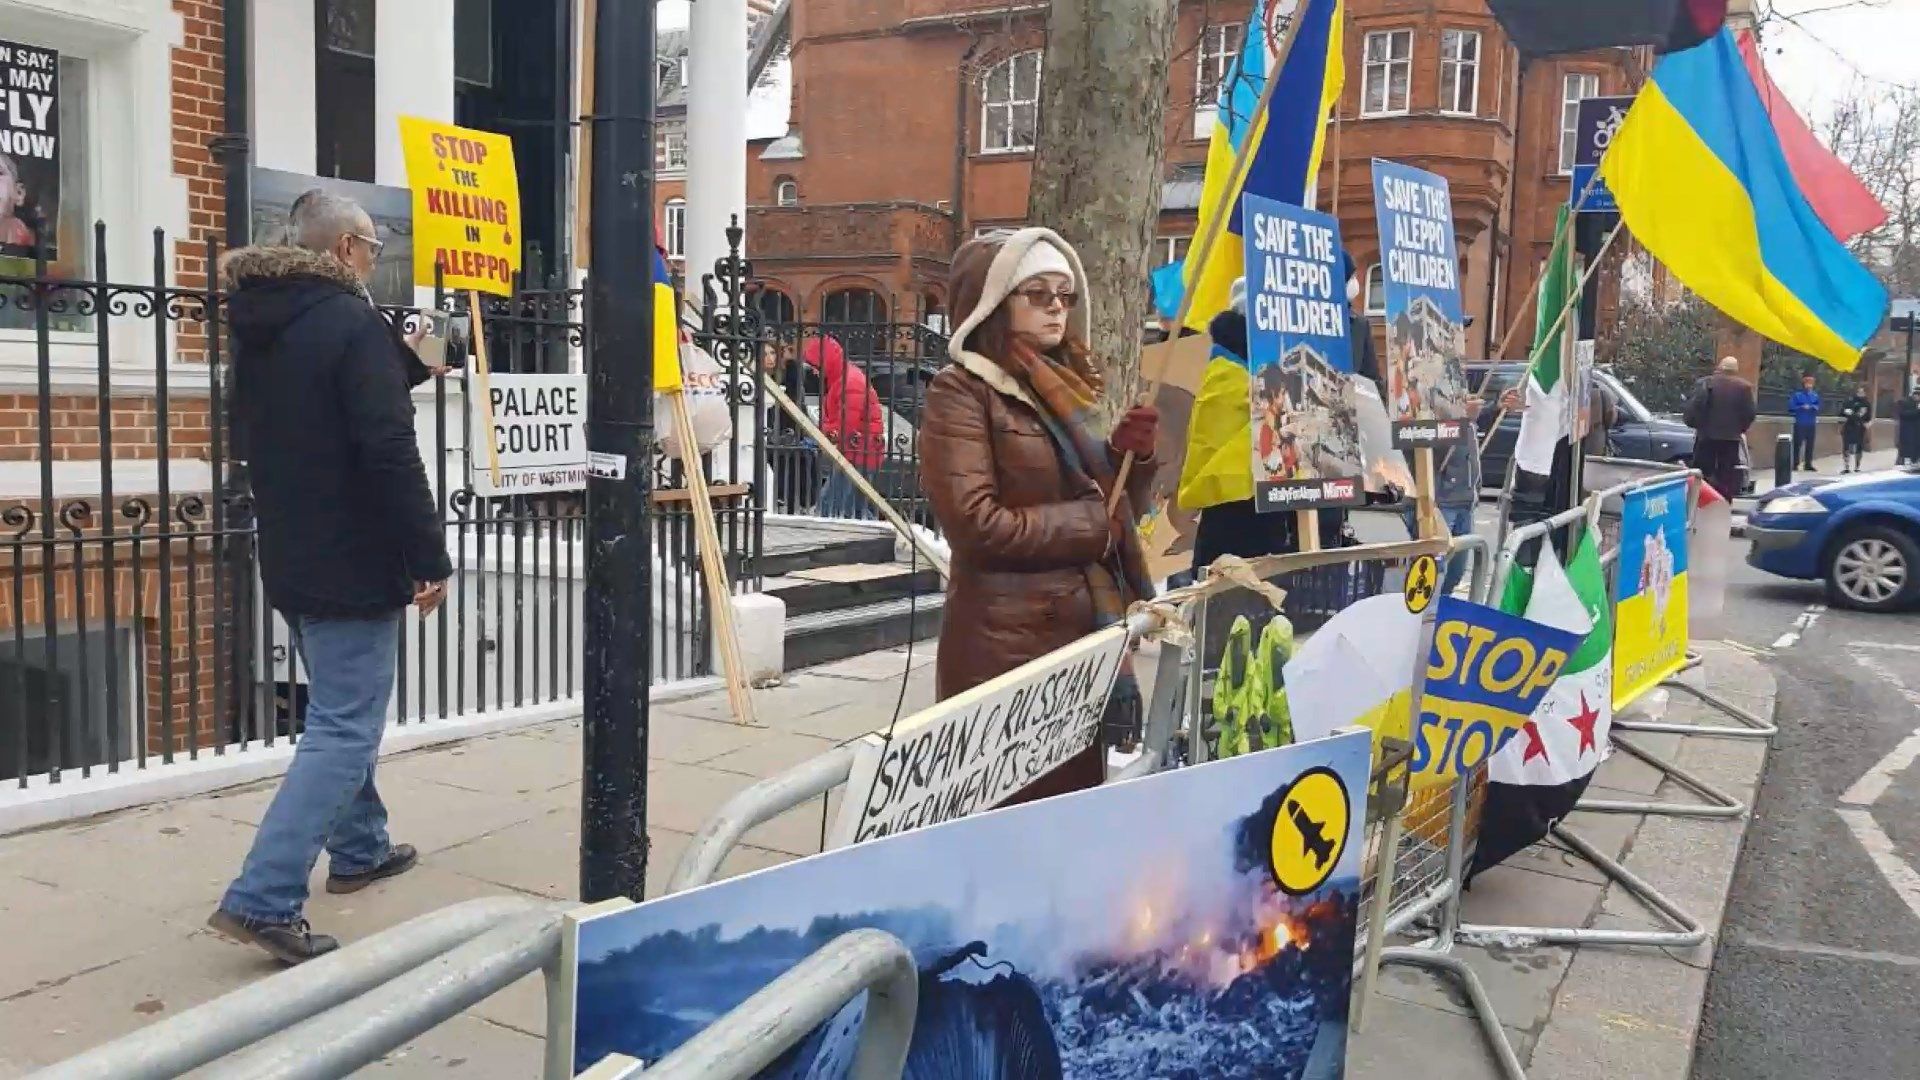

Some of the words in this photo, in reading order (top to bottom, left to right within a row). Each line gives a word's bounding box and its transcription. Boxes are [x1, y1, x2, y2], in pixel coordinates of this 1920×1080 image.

[17, 49, 54, 70] SAY:
[9, 68, 54, 92] MAY
[432, 133, 488, 165] STOP
[451, 168, 480, 188] THE
[427, 187, 508, 225] KILLING
[1382, 175, 1421, 214] SAVE
[1421, 184, 1448, 222] THE
[465, 225, 481, 243] IN
[1254, 212, 1299, 256] SAVE
[1301, 223, 1336, 263] THE
[1394, 213, 1445, 254] ALEPPO
[436, 248, 510, 284] ALEPPO
[1264, 255, 1332, 299] ALEPPO
[1388, 248, 1456, 290] CHILDREN
[1255, 293, 1345, 337] CHILDREN
[490, 387, 578, 418] PALACE
[494, 423, 573, 453] COURT
[493, 473, 518, 488] ITY
[522, 472, 536, 486] OF
[1426, 620, 1568, 699] STOP
[869, 703, 983, 817] SYRIAN
[996, 651, 1107, 750] RUSSIAN
